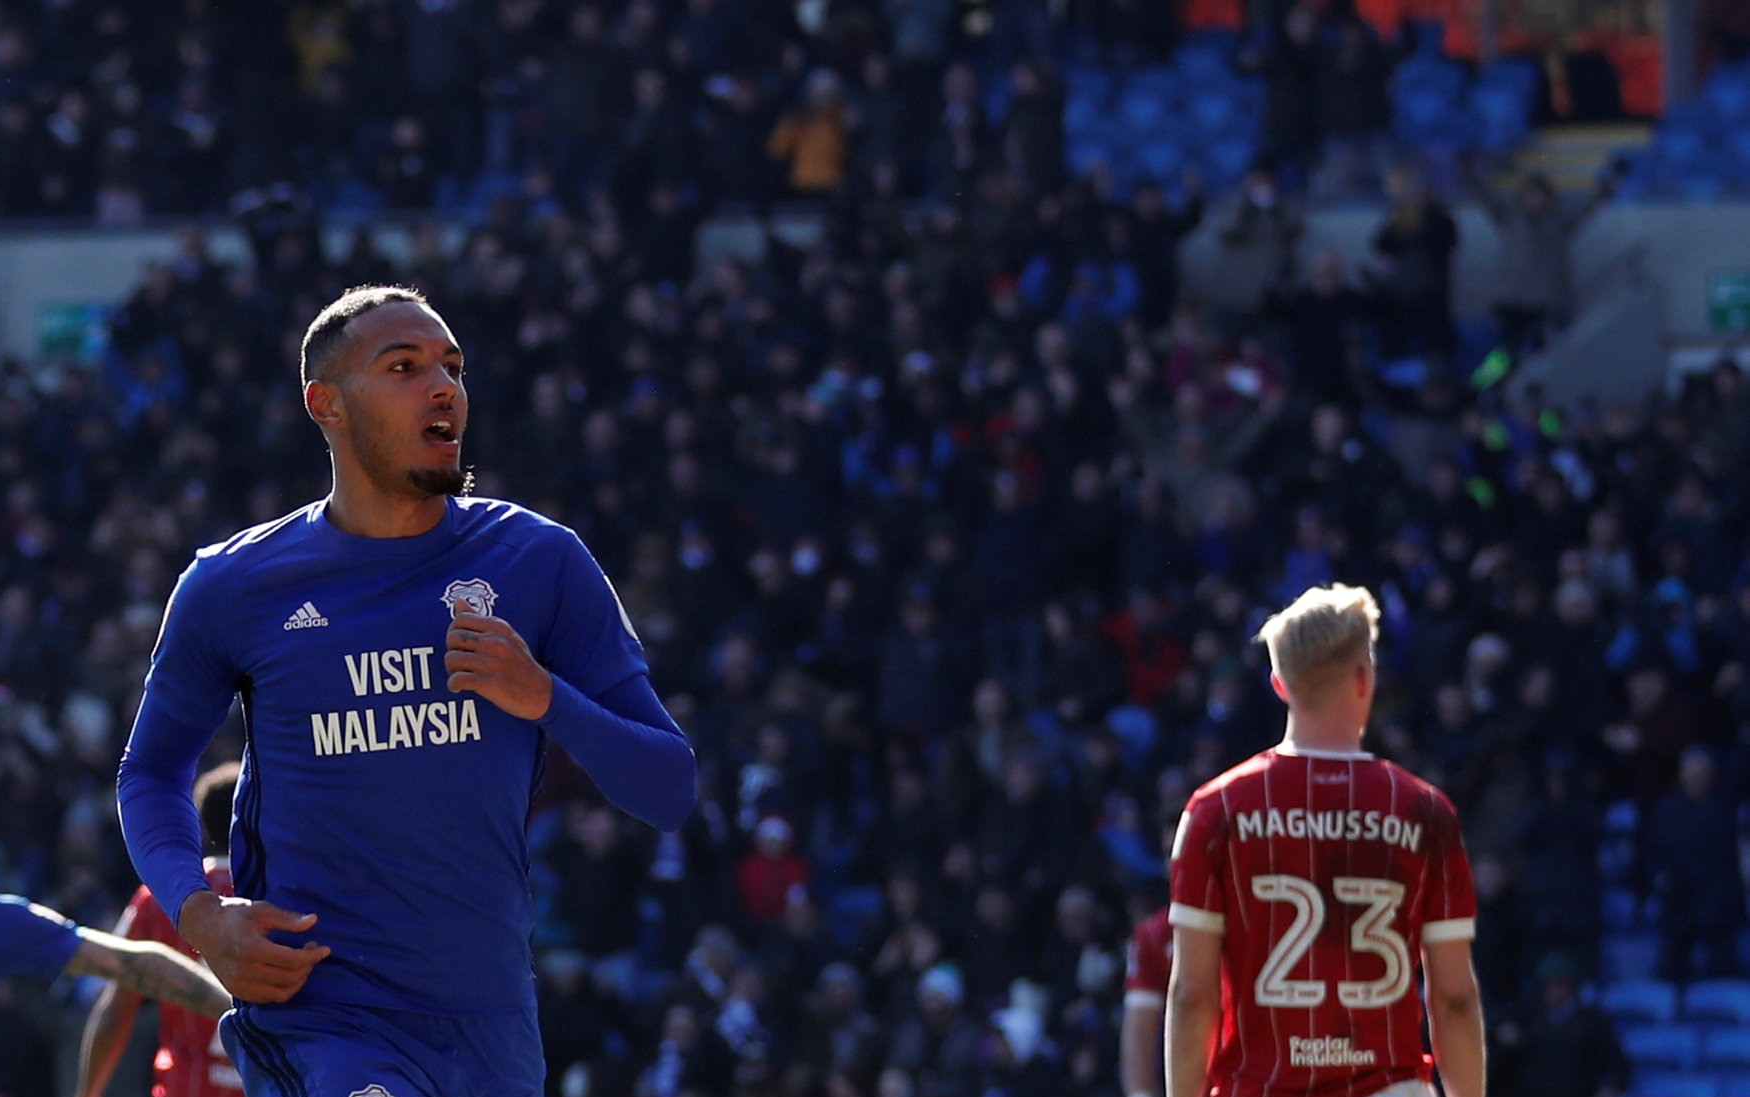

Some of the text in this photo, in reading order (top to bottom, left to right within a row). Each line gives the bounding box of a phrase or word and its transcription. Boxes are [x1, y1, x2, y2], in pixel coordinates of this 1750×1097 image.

[283, 615, 329, 631] adidas
[344, 646, 434, 697] VISIT
[310, 699, 482, 757] MALAYSIA
[1236, 808, 1422, 852] MAGNUSSON
[1251, 874, 1412, 1010] 23
[1289, 1034, 1350, 1055] Poplar
[1289, 1046, 1375, 1067] Insulation
